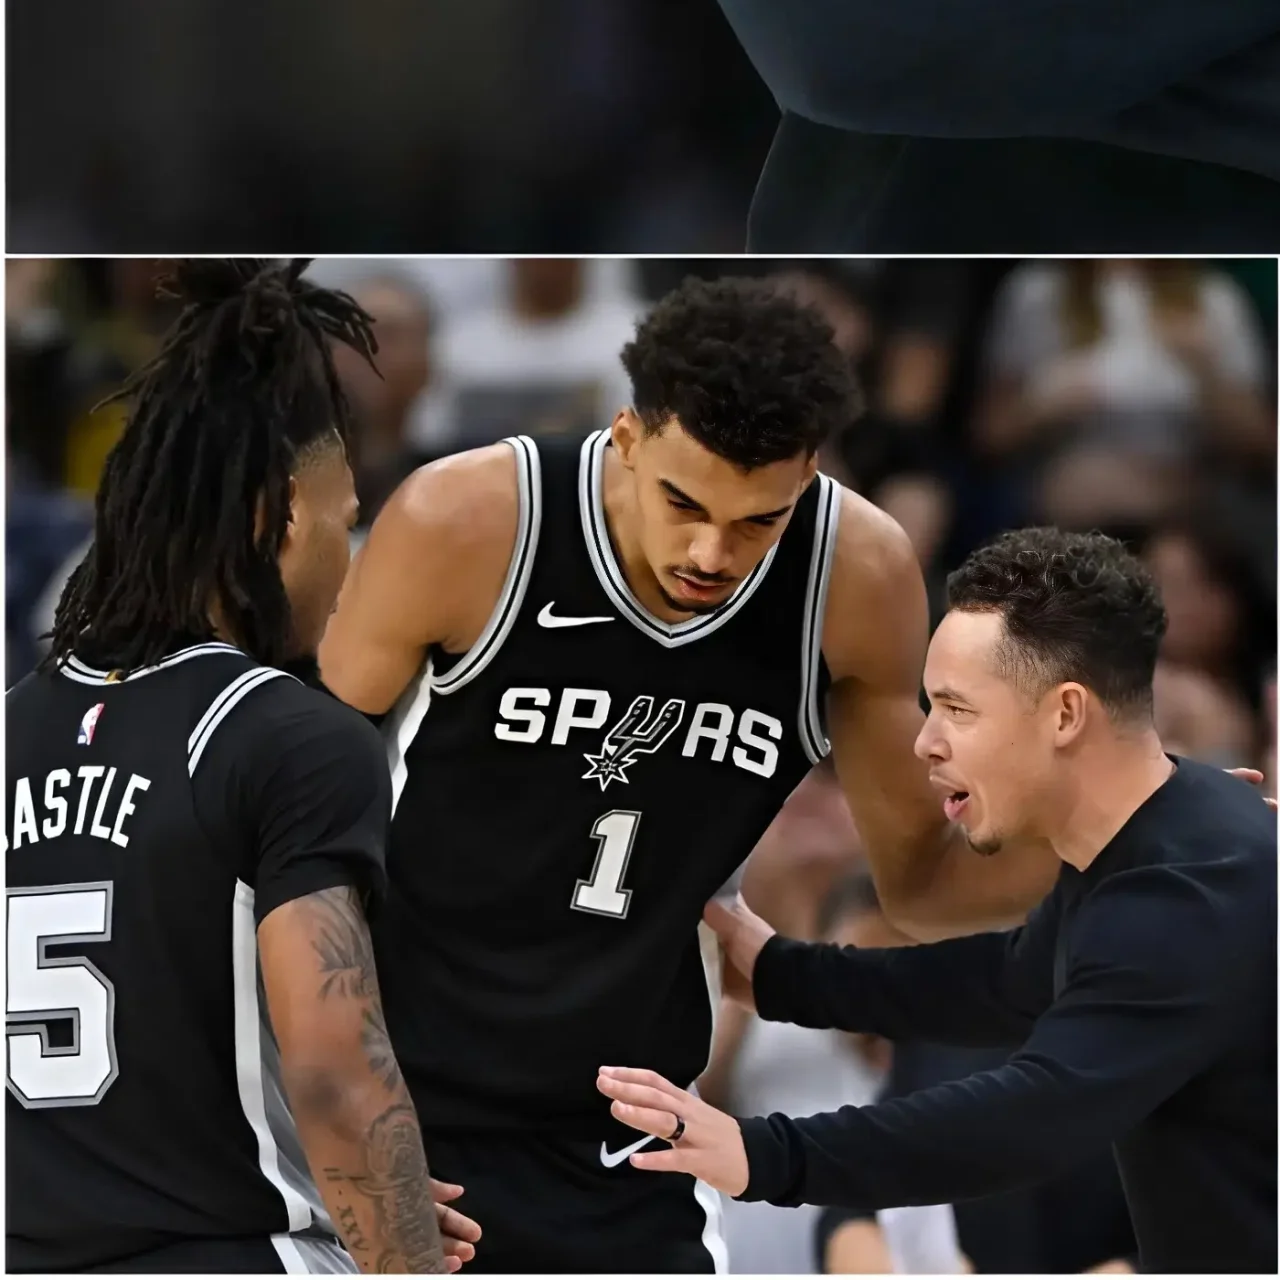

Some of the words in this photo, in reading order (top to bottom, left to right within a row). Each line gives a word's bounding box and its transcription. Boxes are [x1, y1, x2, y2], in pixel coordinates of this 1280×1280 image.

[6, 765, 152, 850] ASTLE
[570, 809, 642, 920] 1
[6, 880, 120, 1110] 5
